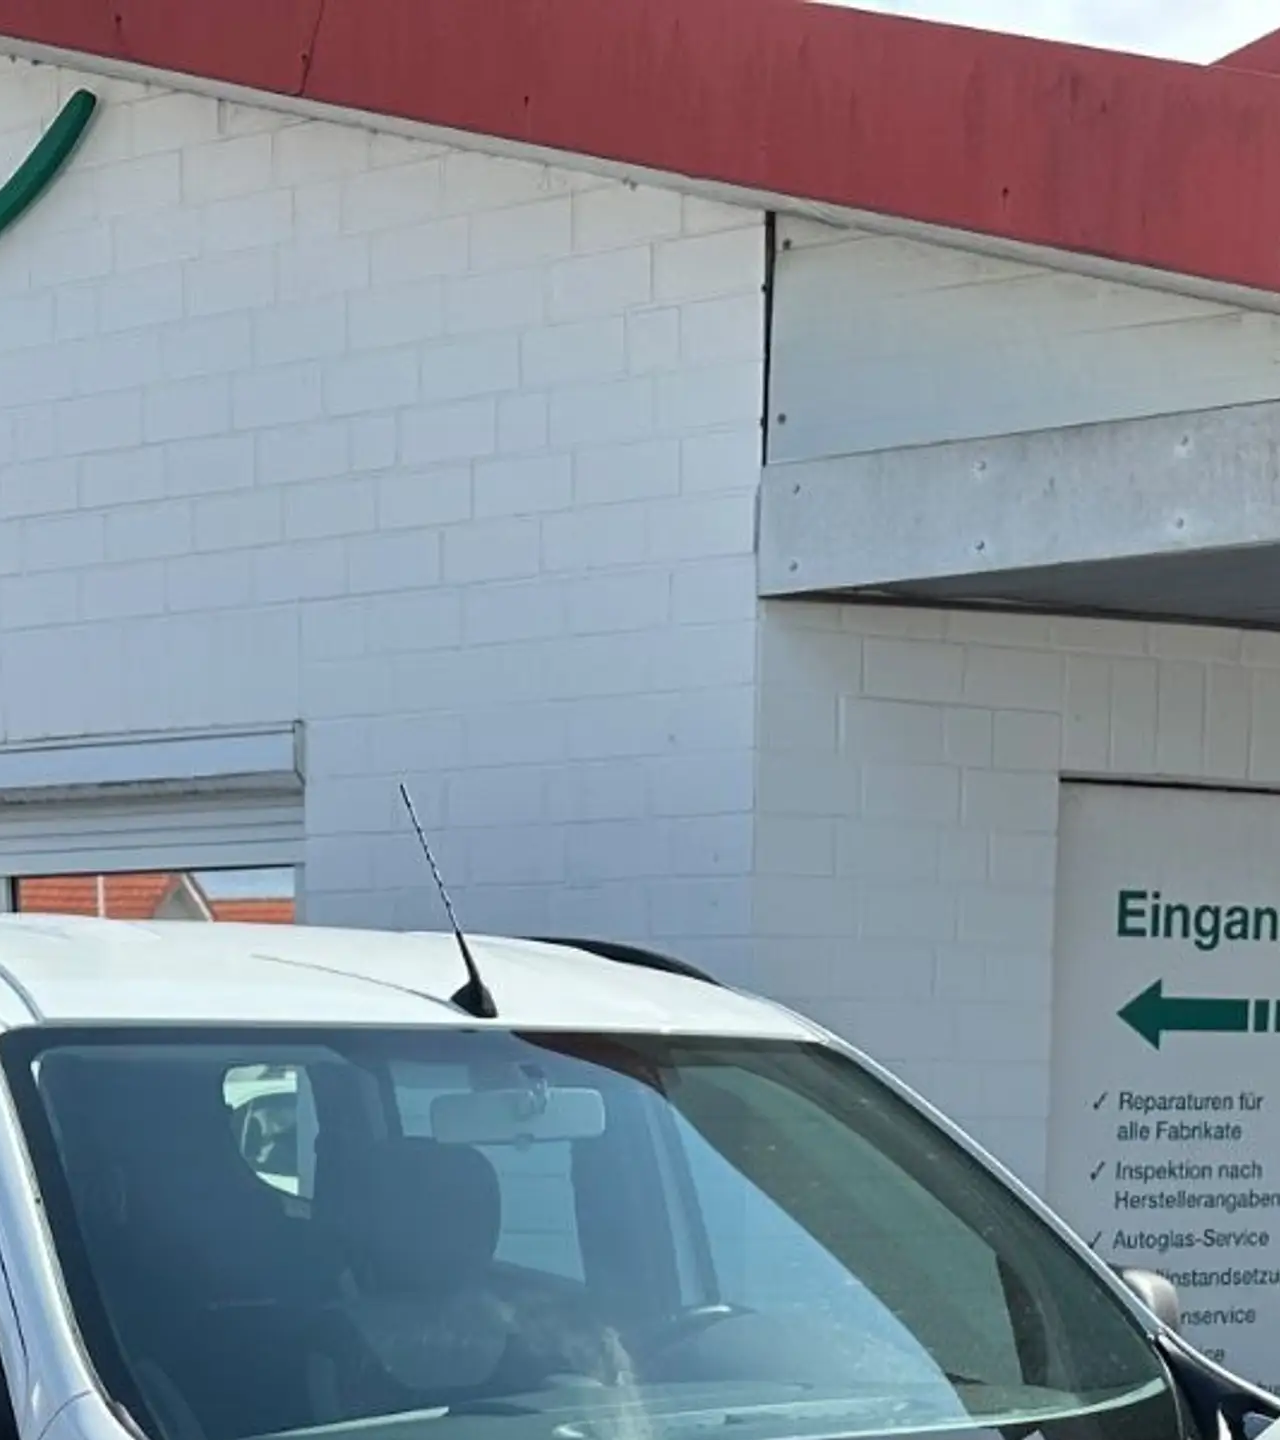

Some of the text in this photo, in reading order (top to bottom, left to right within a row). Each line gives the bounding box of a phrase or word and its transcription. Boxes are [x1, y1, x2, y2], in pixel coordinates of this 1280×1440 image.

[1119, 1091, 1263, 1114] Reparaturen für
[1117, 1122, 1243, 1141] alle Fabrikate
[1115, 1161, 1262, 1183] Inspektion nach
[1113, 1229, 1270, 1252] Autoglas-Service
